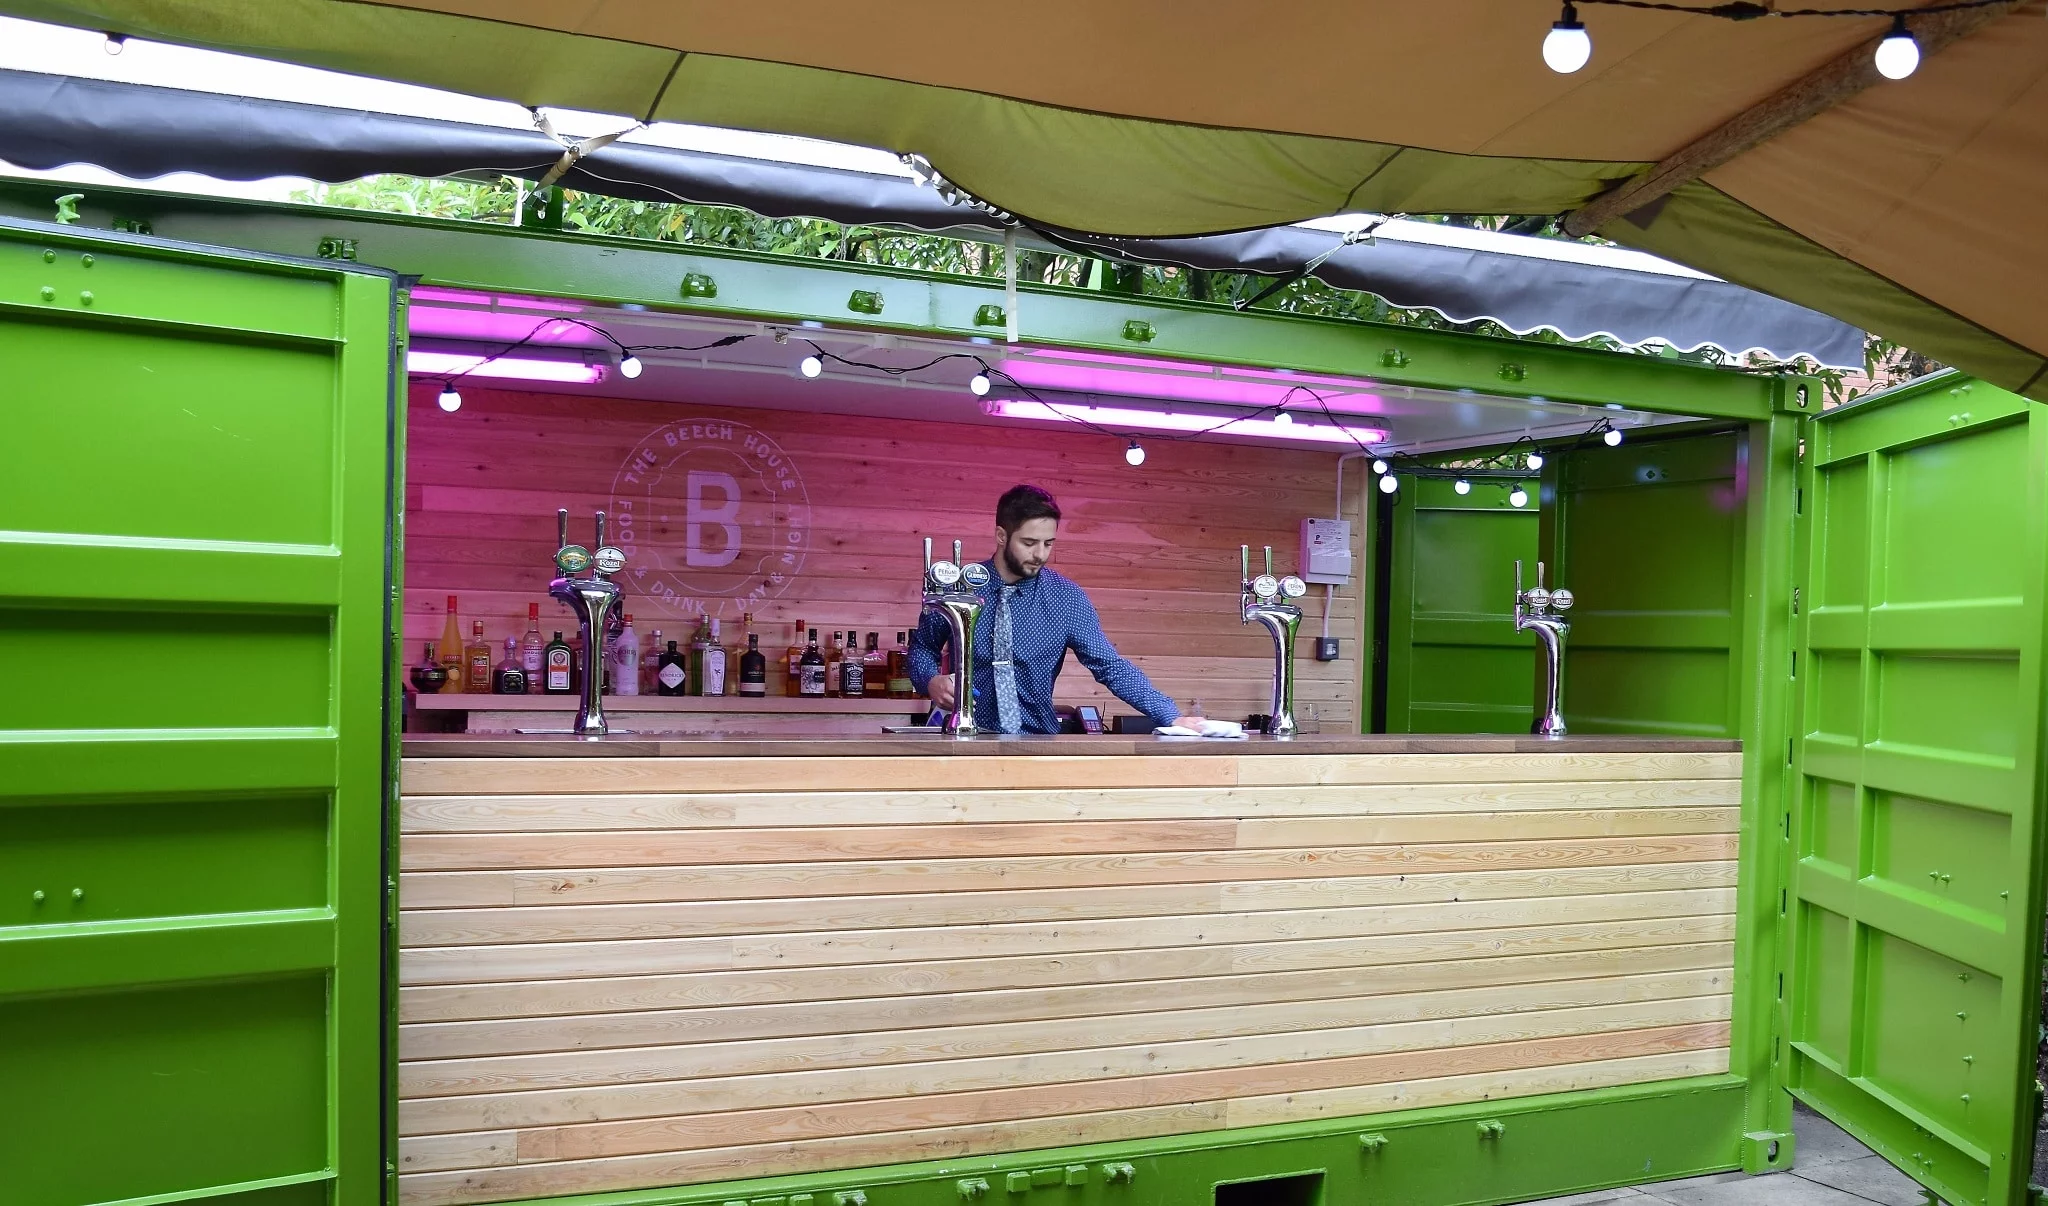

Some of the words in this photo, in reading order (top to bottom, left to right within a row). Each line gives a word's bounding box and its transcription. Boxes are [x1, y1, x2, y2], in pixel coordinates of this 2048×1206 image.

[624, 448, 657, 486] THE
[664, 423, 733, 448] BEECH
[744, 435, 796, 490] HOUSE
[618, 500, 637, 557] FOOD
[650, 580, 705, 614] DRINK
[735, 584, 768, 612] DAY
[783, 505, 802, 565] NIGHT
[686, 469, 742, 567] B
[599, 559, 620, 568] Kozel
